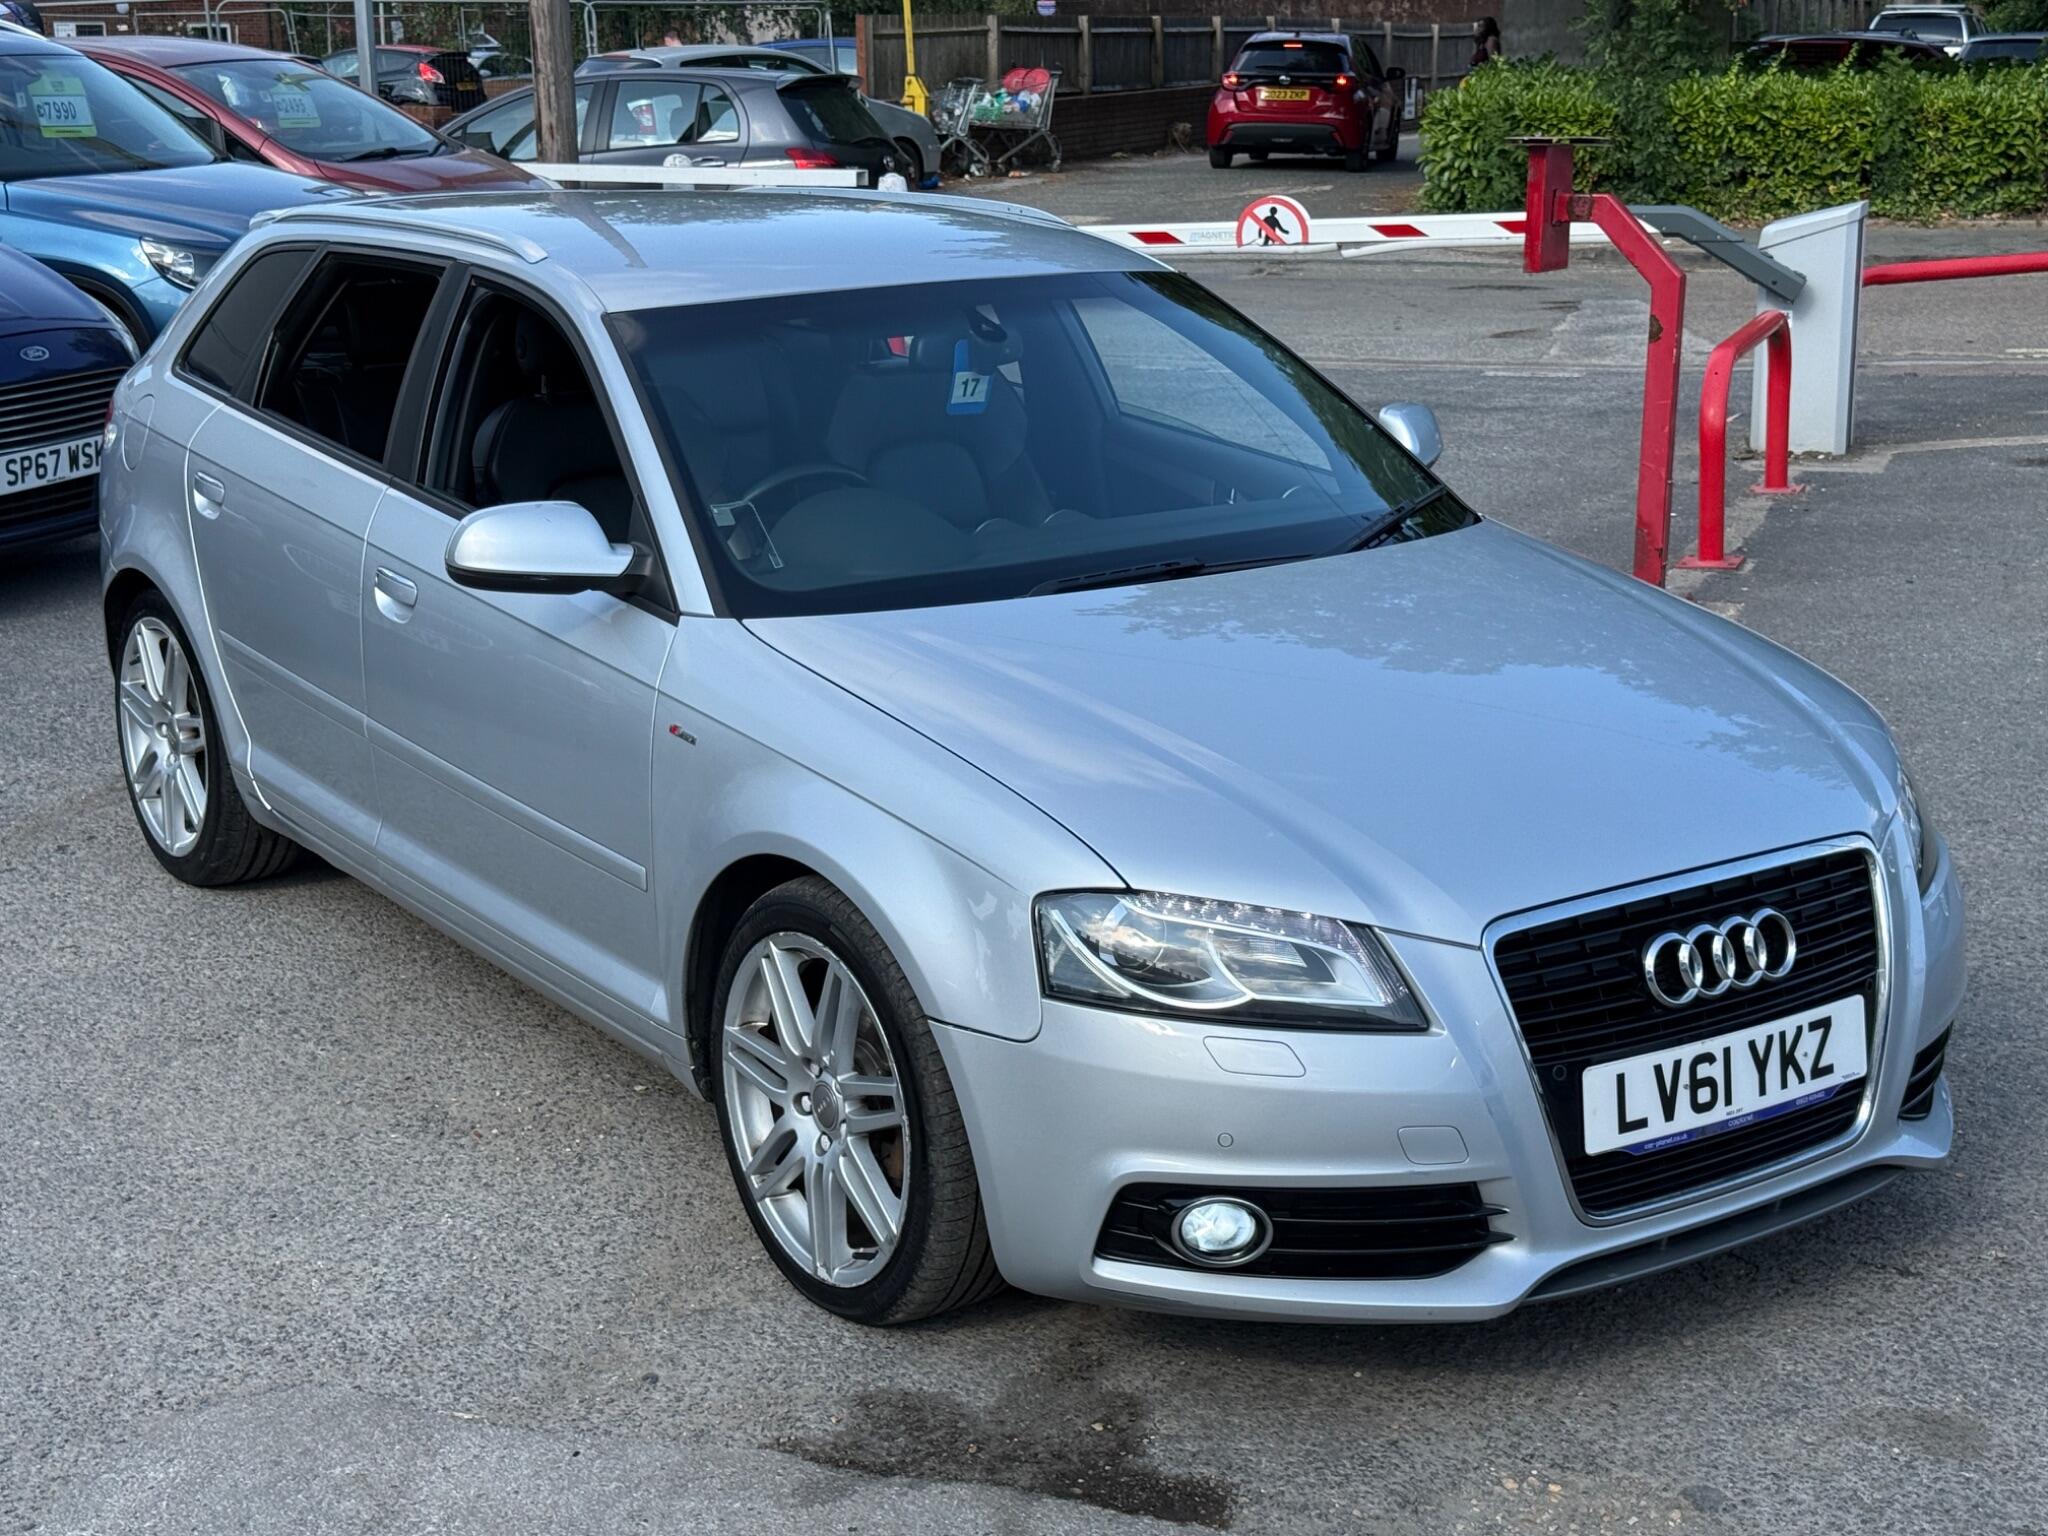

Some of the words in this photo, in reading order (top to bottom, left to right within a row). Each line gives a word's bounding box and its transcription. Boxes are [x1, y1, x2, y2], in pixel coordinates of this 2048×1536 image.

[961, 378, 980, 397] 17
[5, 448, 61, 486] SP67
[1616, 1045, 1733, 1135] LV61
[1747, 1015, 1835, 1097] YKZ
